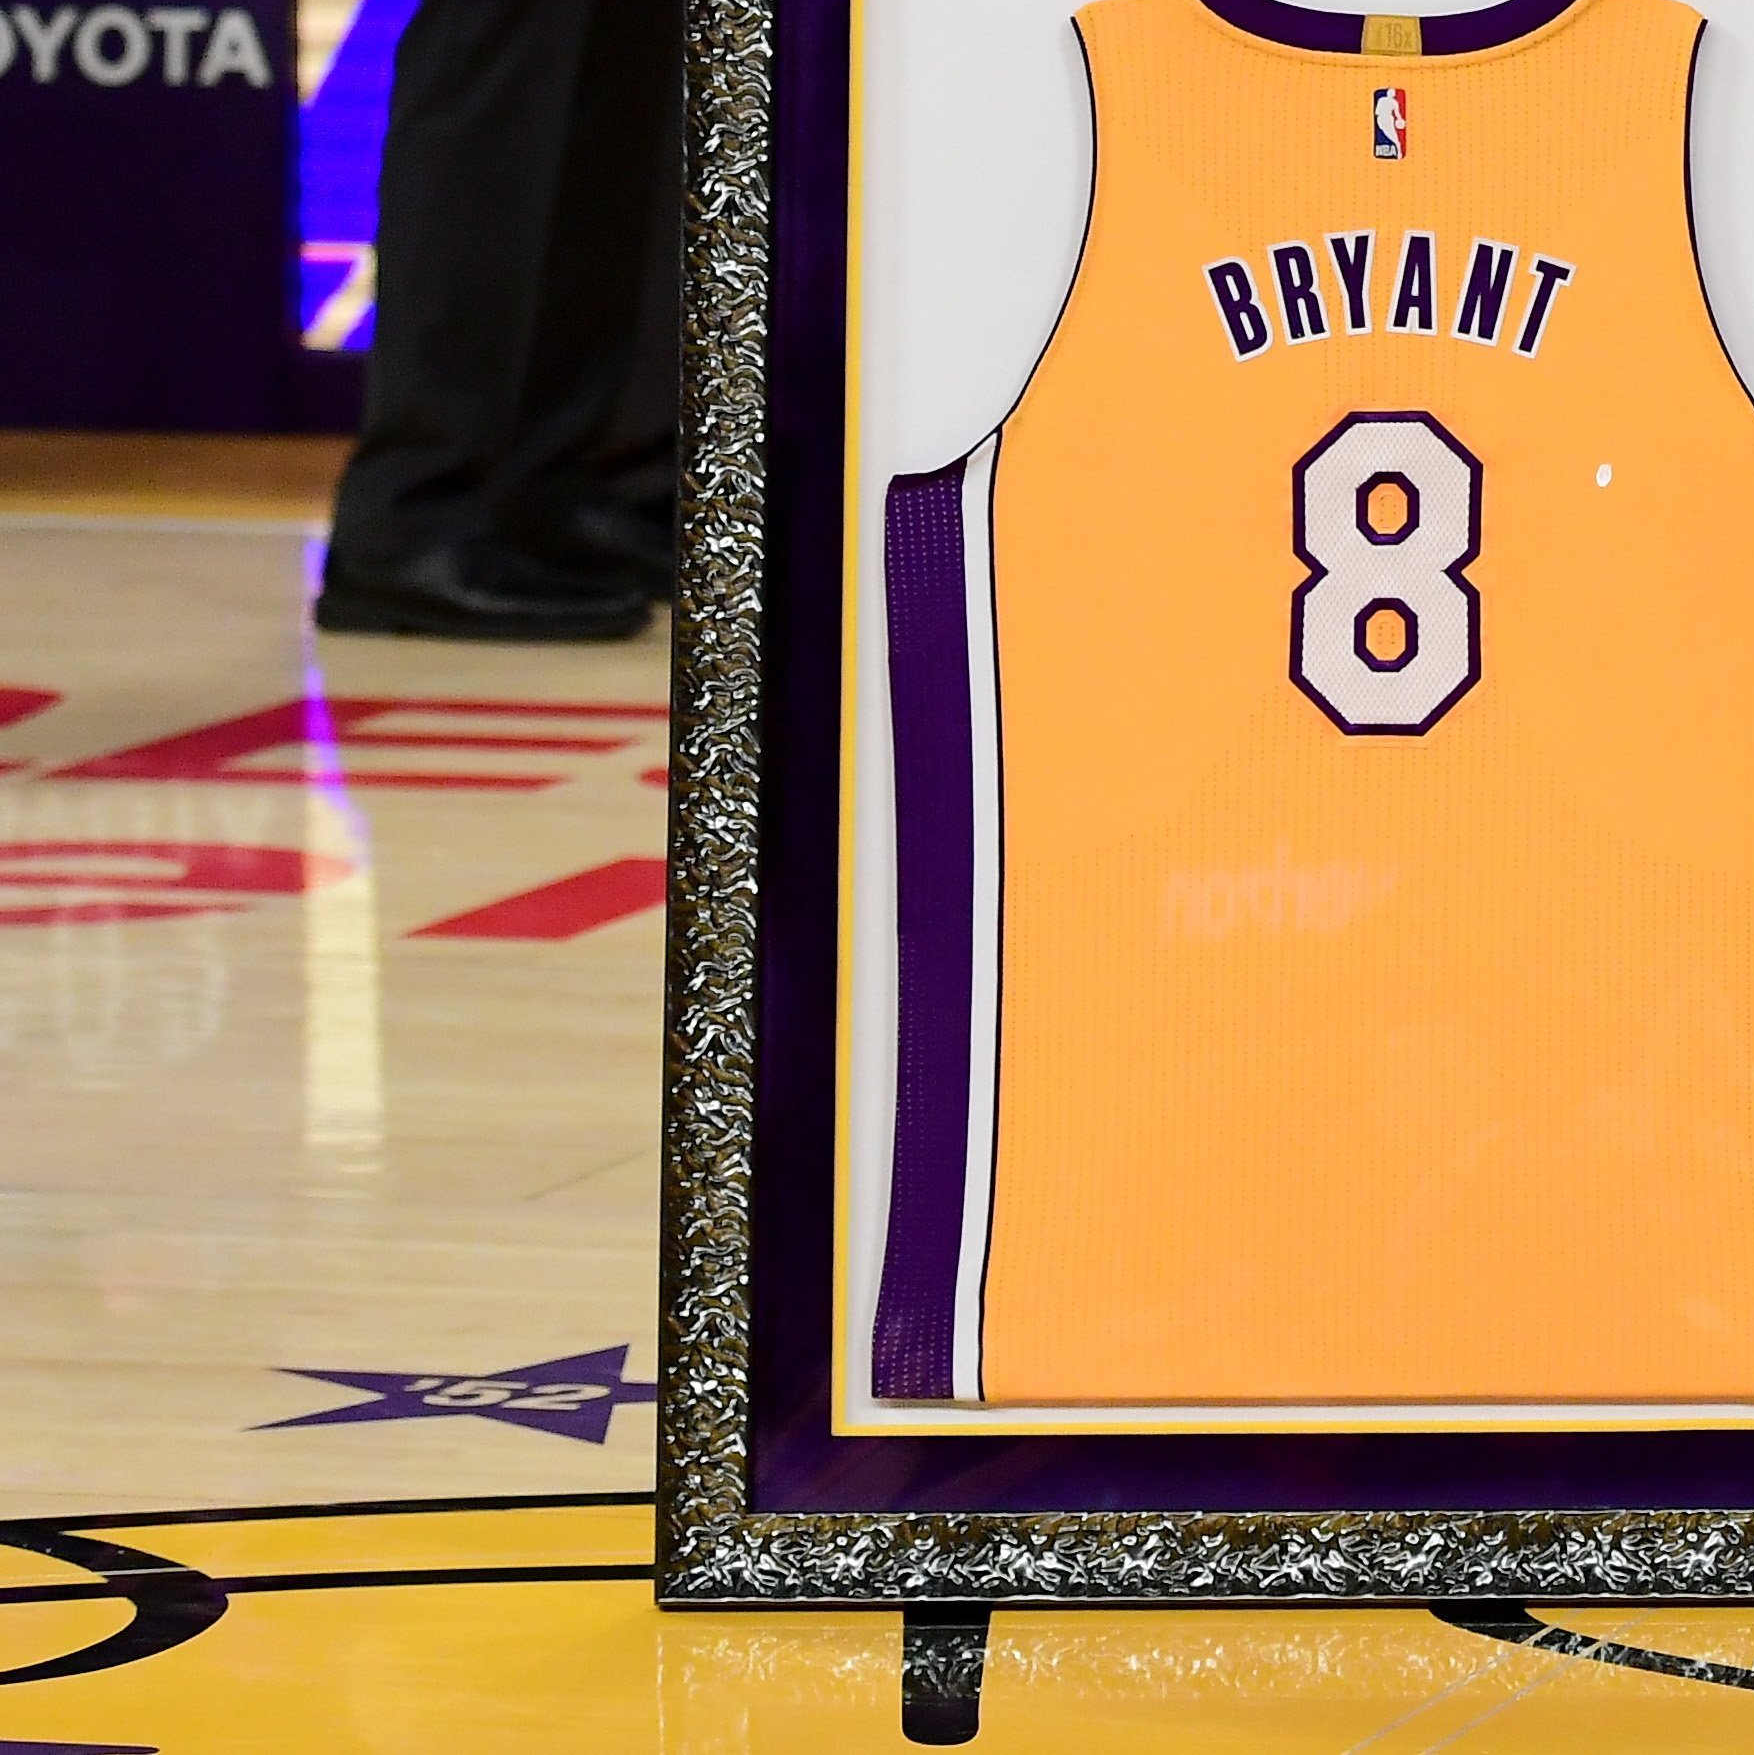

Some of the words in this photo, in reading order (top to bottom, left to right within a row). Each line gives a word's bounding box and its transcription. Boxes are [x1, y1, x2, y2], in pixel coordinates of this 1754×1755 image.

[0, 3, 271, 89] YOTA
[1375, 144, 1397, 157] NBA
[1204, 230, 1577, 362] BRYANT
[1289, 410, 1484, 737] 8
